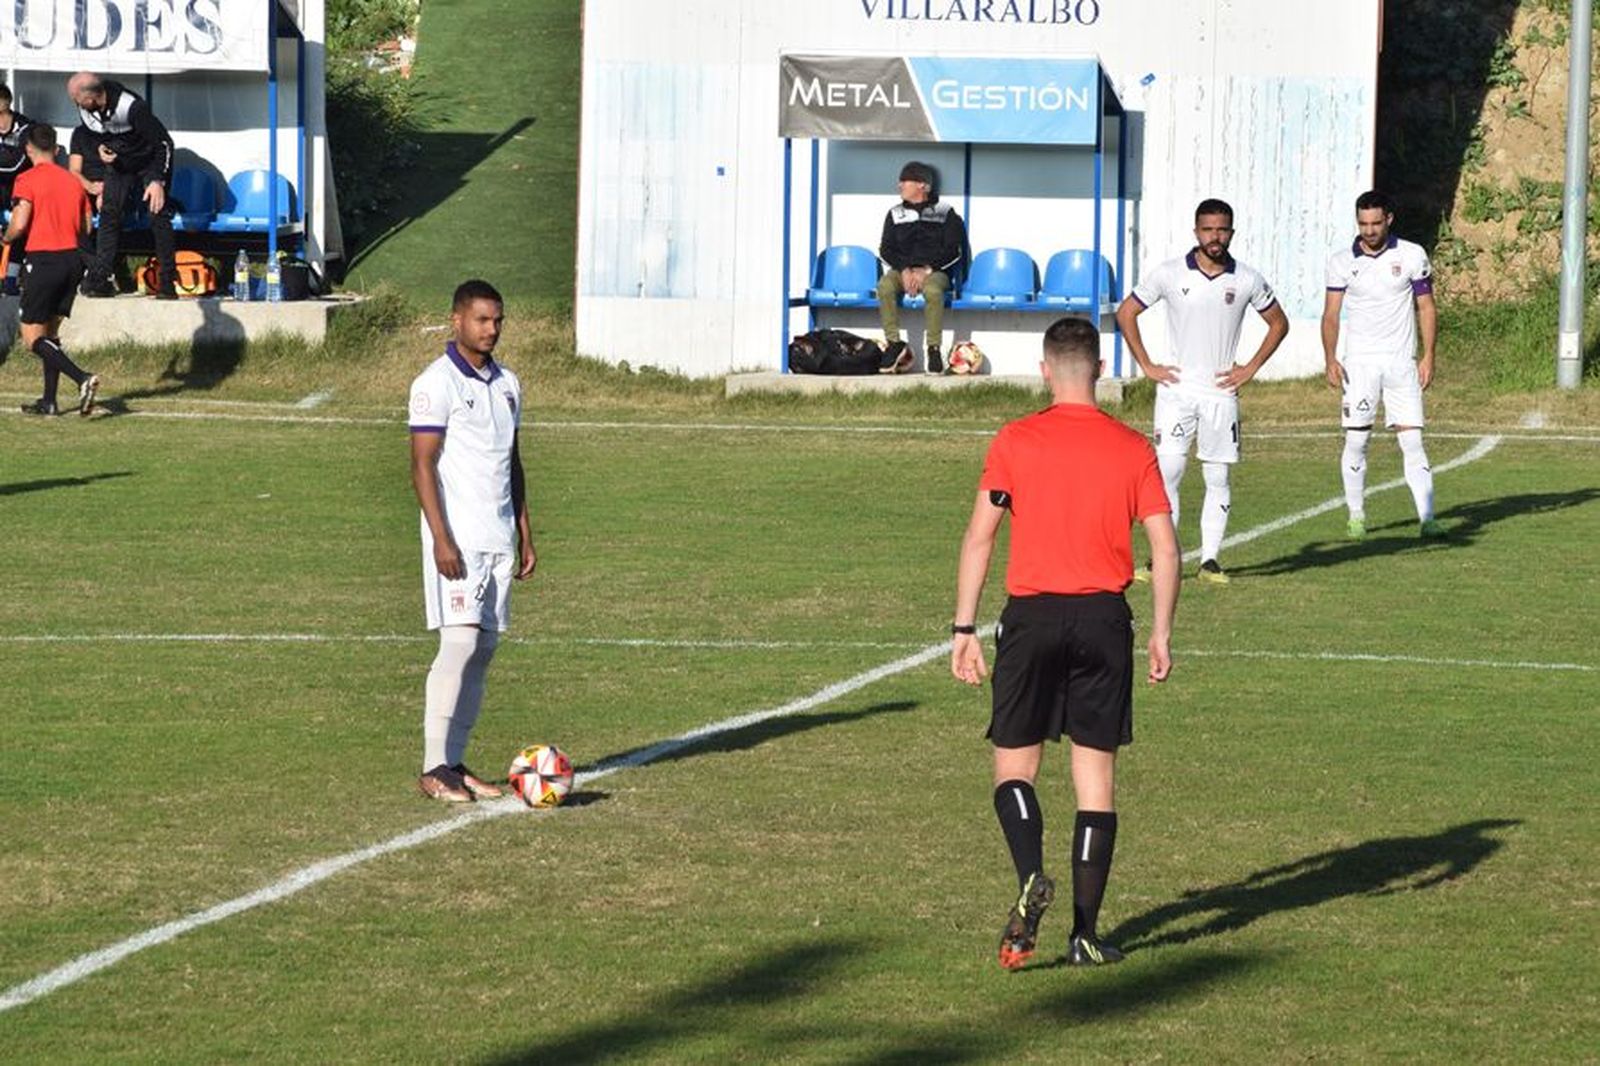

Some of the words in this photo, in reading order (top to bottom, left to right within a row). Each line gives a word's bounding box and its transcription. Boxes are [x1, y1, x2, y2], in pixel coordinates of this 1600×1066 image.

[0, 0, 224, 54] UDES
[860, 0, 1101, 26] VILLARALBO
[788, 77, 911, 108] METAL
[932, 79, 1089, 112] GESTIÓN
